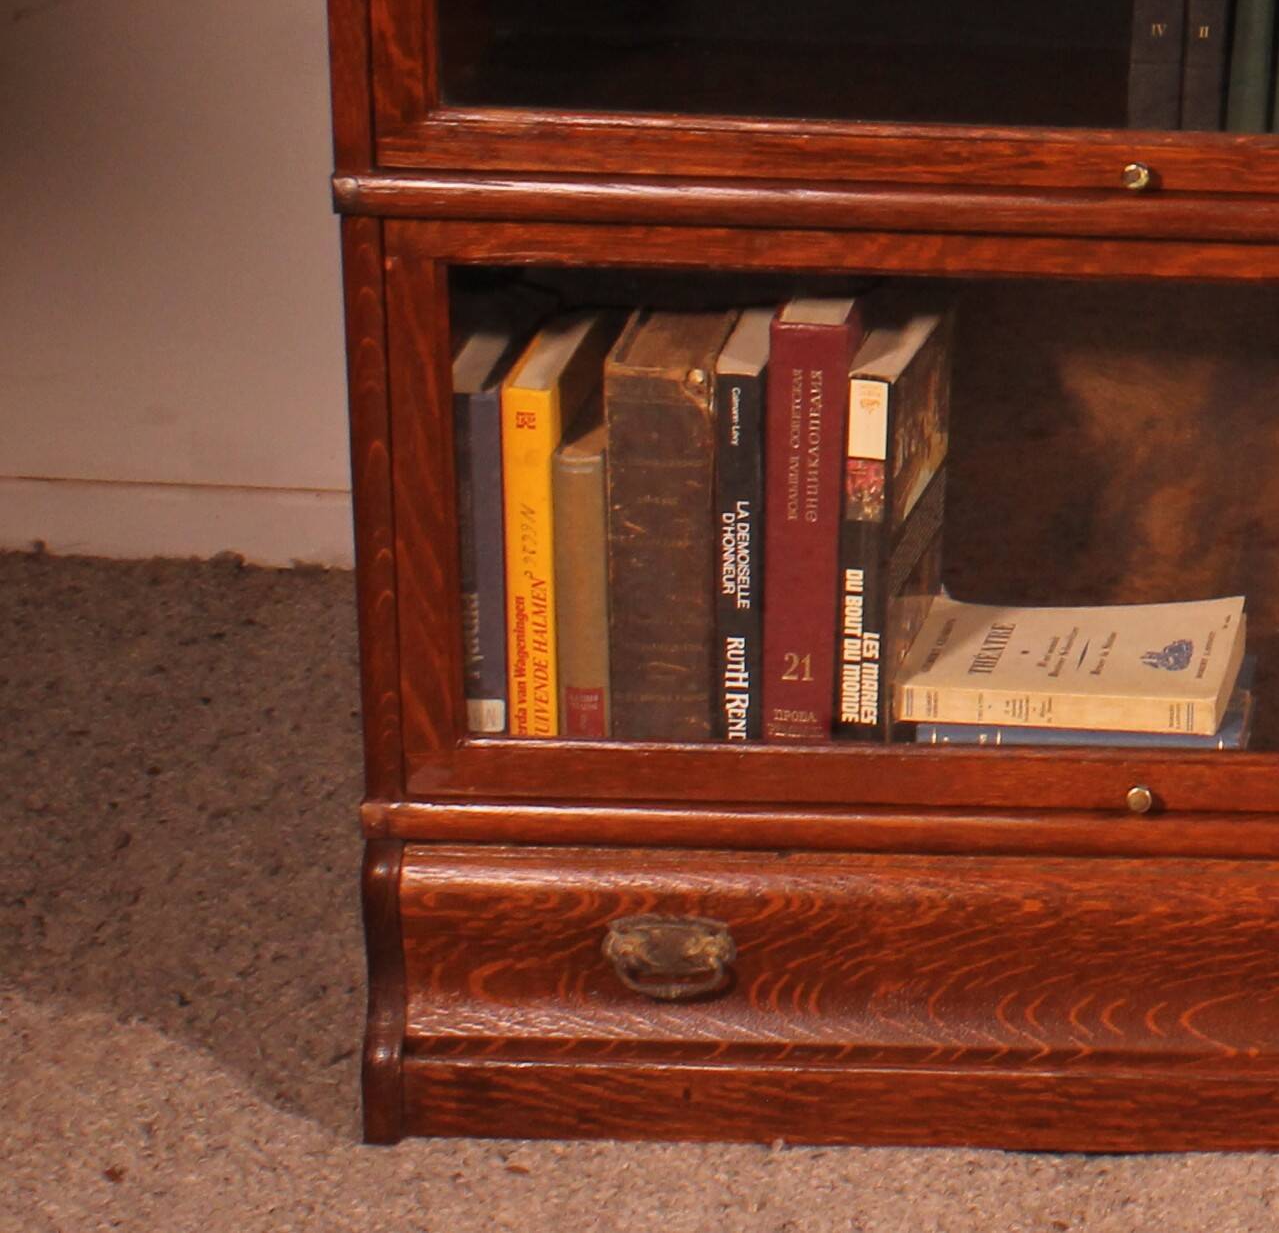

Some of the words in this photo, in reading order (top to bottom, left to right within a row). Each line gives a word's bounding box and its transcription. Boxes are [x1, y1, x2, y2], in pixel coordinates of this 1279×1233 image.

[805, 369, 823, 523] ЭНЦИКЛОПЕДИЯ
[736, 500, 750, 519] LA
[721, 511, 736, 595] D'HONNEUR
[736, 522, 751, 610] DEMOISELLE
[845, 568, 864, 593] DU
[514, 595, 530, 679] Wageningen
[529, 576, 550, 655] HALMEN
[844, 595, 864, 637] BOUT
[724, 636, 749, 689] RUTH
[781, 653, 815, 681] 21
[843, 638, 862, 662] DU
[862, 631, 881, 659] LES
[515, 681, 528, 705] van
[531, 659, 551, 736] UIVENDE
[841, 663, 861, 723] MONDE
[860, 662, 880, 726] MARIES
[515, 707, 528, 736] erda
